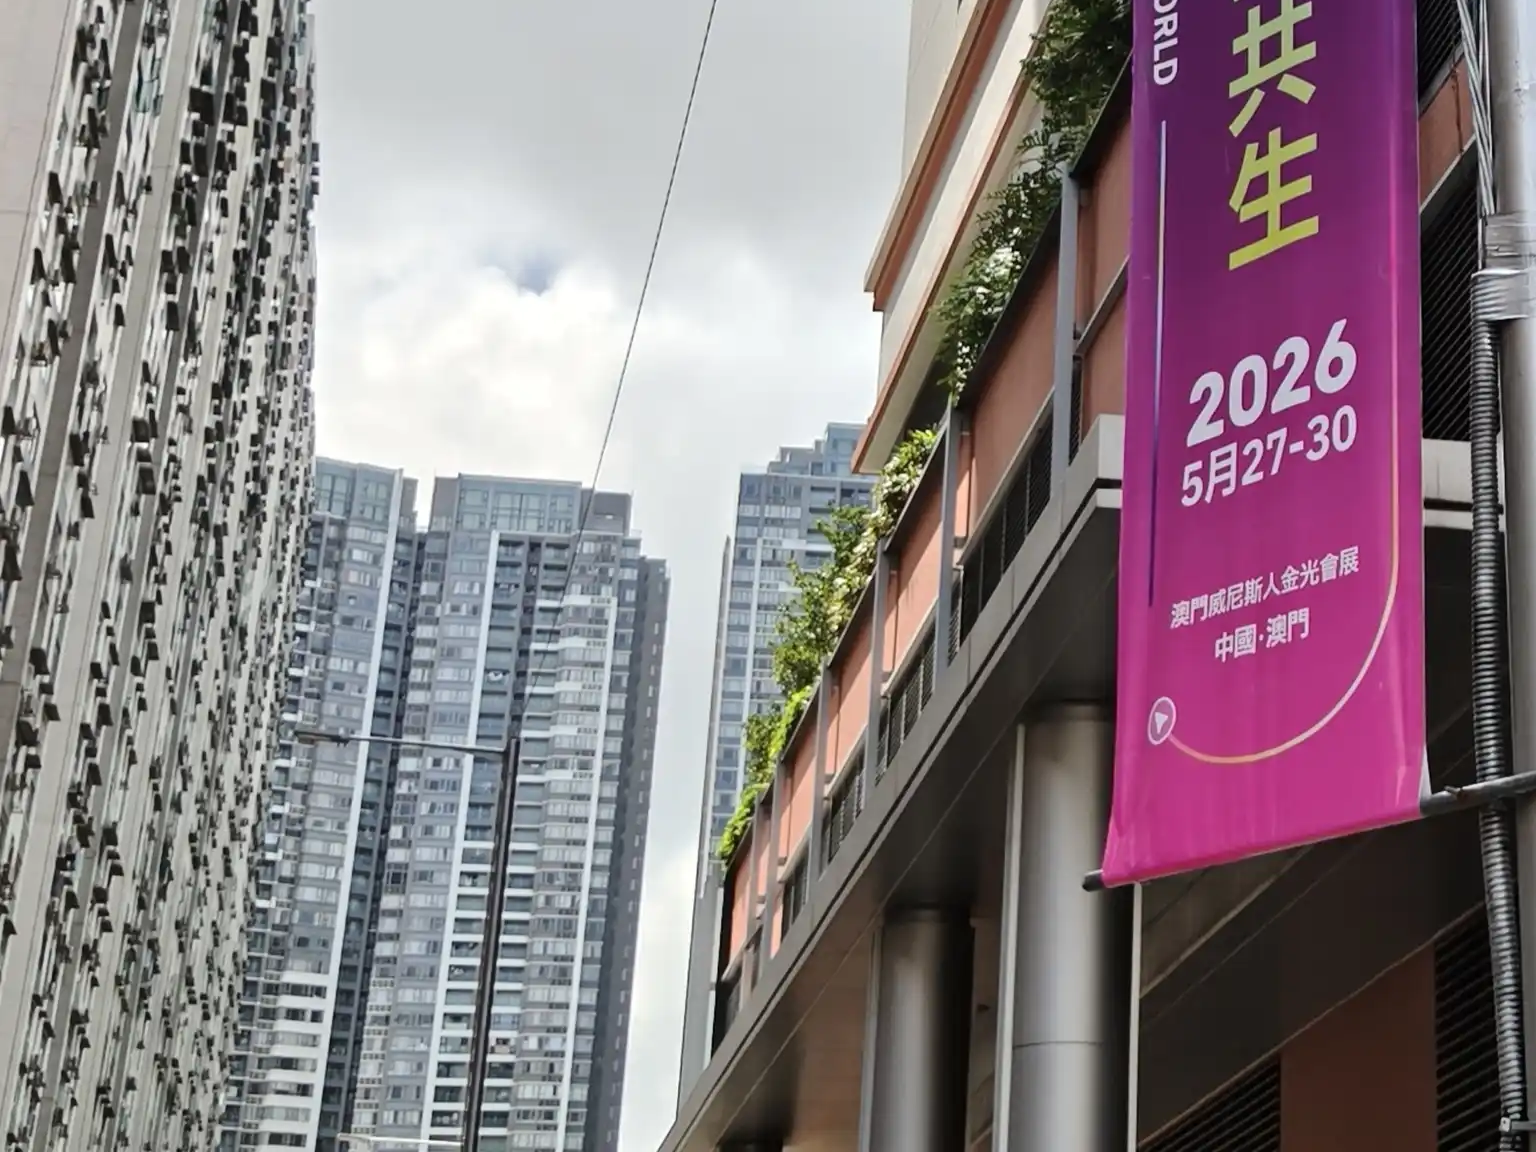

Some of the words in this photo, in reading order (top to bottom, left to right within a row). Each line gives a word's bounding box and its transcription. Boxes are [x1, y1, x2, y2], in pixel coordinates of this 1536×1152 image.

[1186, 318, 1357, 448] 2026
[1181, 404, 1357, 507] 5月27-30
[1170, 546, 1359, 628] 澳門威尼斯人金光會展
